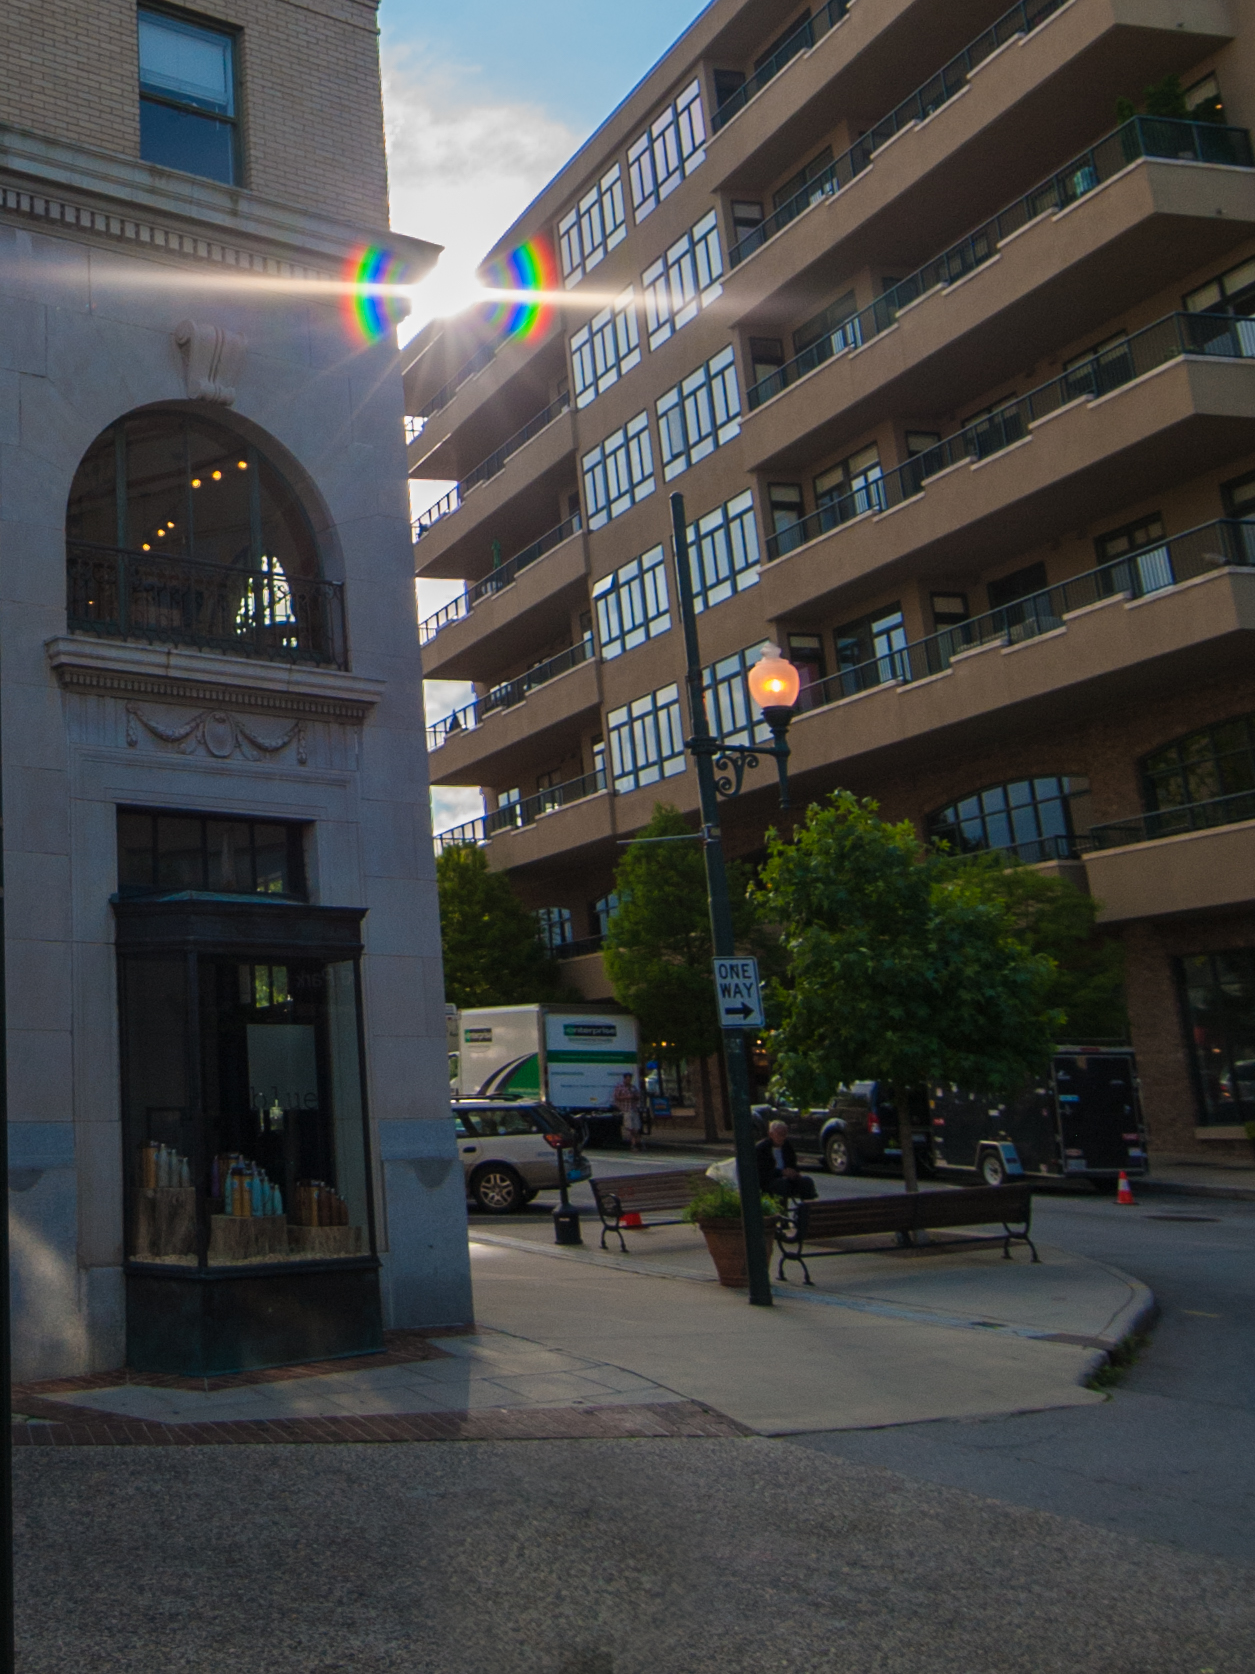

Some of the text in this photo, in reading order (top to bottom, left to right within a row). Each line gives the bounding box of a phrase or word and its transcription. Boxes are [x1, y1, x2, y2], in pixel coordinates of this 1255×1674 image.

[718, 963, 752, 979] ONE
[719, 982, 753, 998] WAY
[566, 1026, 616, 1036] enterprise
[250, 1085, 318, 1110] blue
